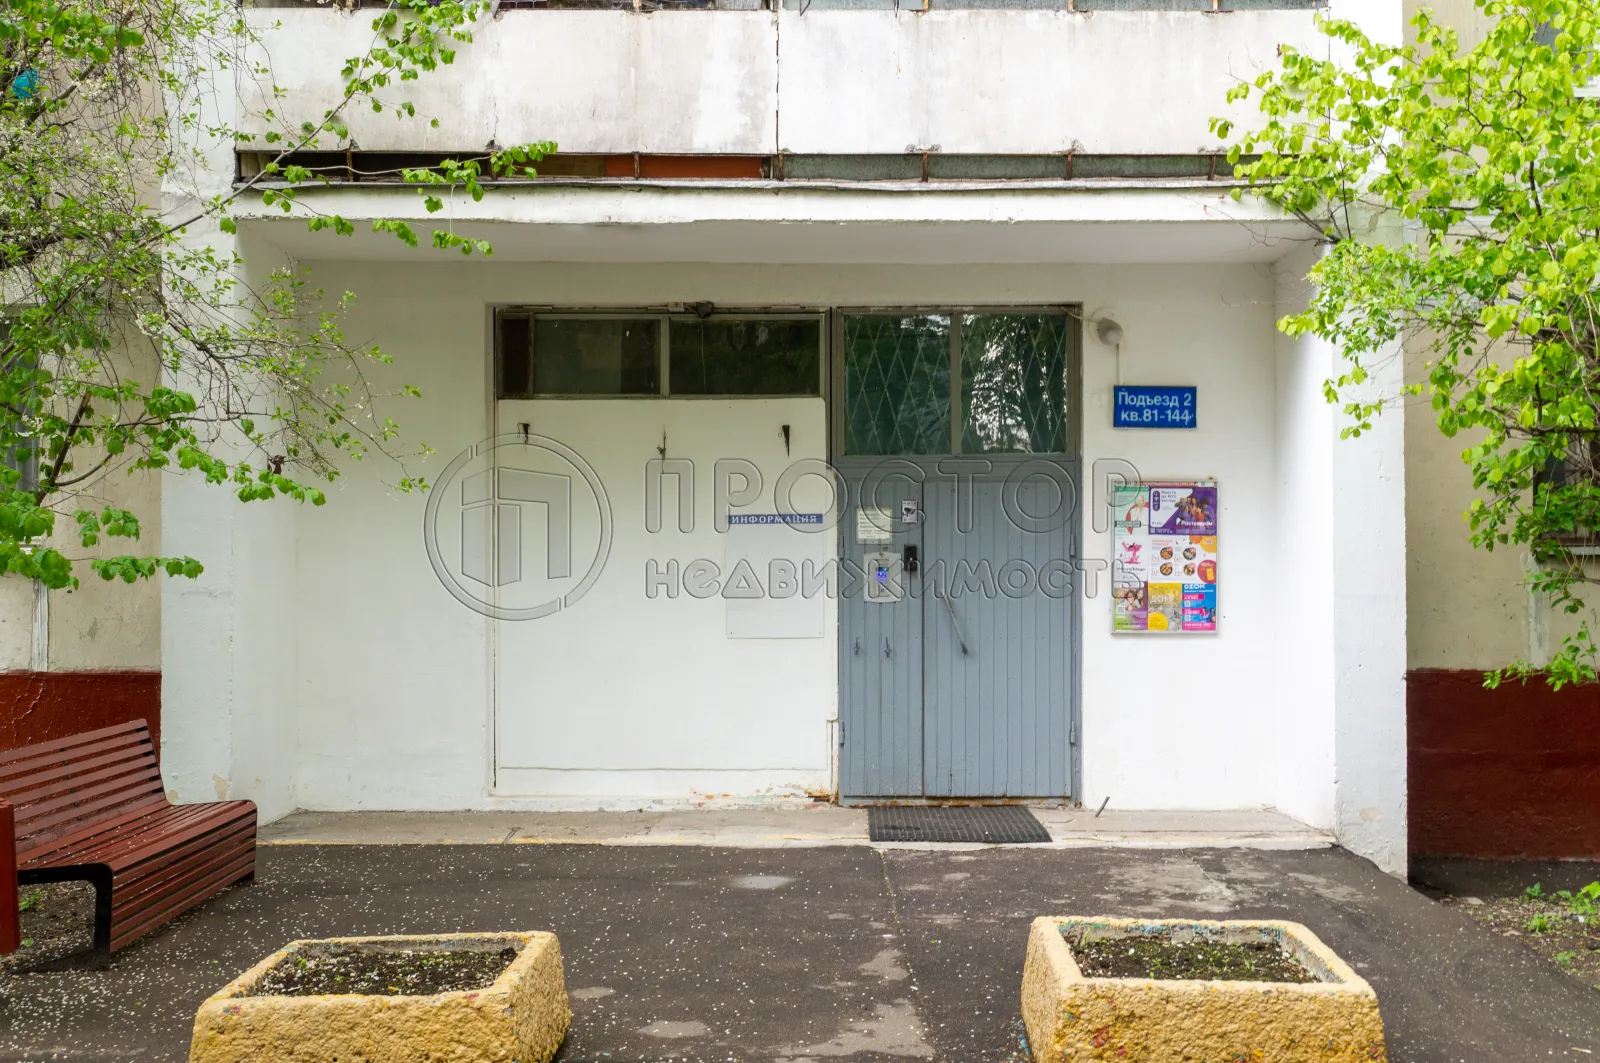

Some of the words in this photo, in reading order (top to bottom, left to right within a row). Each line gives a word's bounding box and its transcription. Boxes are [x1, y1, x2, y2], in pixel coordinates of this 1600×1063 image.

[1118, 391, 1180, 408] Подъезд
[1183, 393, 1192, 406] 2
[1121, 408, 1190, 422] кв.81-144
[731, 515, 817, 524] ИНФОРМАЦИЯ
